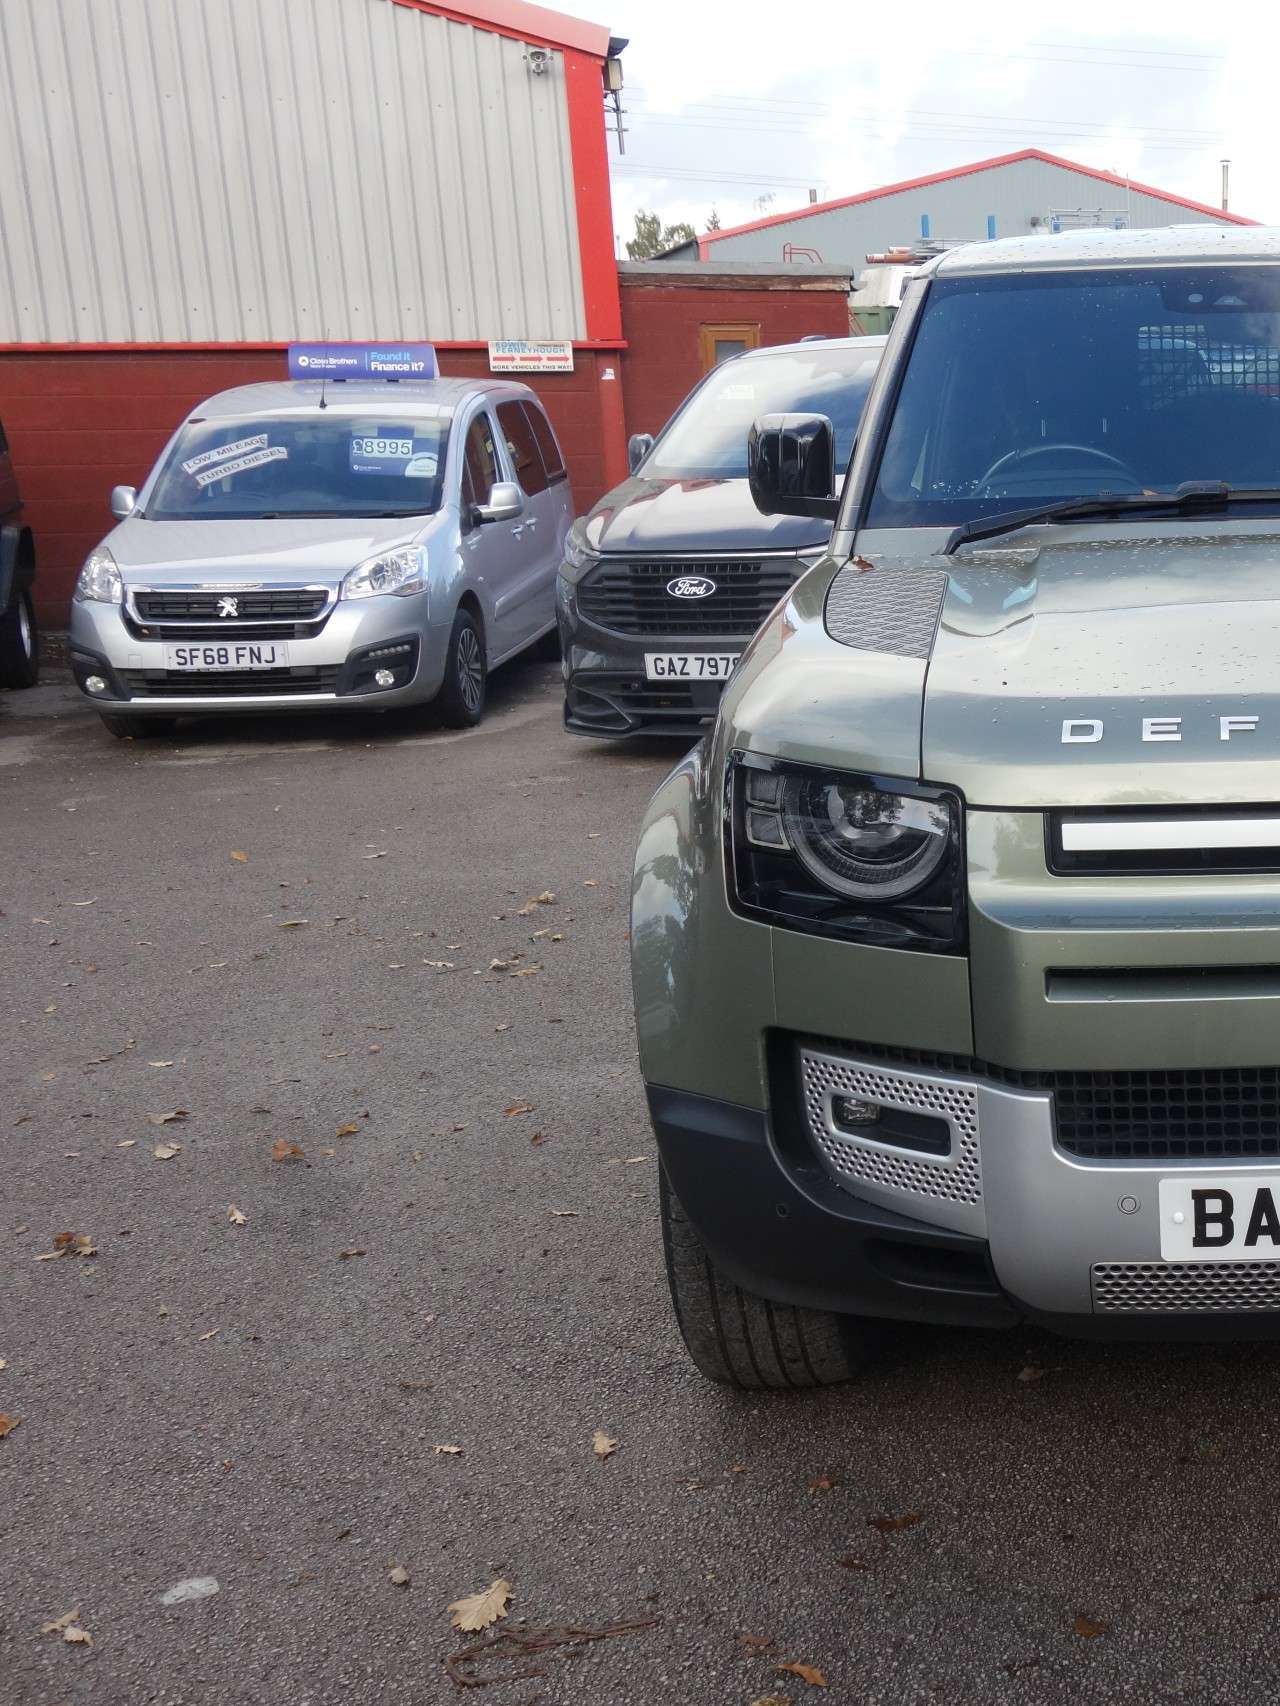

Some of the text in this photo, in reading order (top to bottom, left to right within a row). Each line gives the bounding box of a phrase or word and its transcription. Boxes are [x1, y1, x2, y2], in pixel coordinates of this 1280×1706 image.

[329, 357, 357, 365] Brothers
[371, 352, 401, 361] Found
[371, 361, 409, 371] Finance
[186, 437, 265, 469] LOW MILEAGE
[352, 439, 410, 456] £8995
[200, 448, 286, 482] TURBO DIESEL
[675, 579, 706, 594] Ford
[176, 646, 276, 666] SF68 FNJ
[653, 657, 690, 676] GAZ
